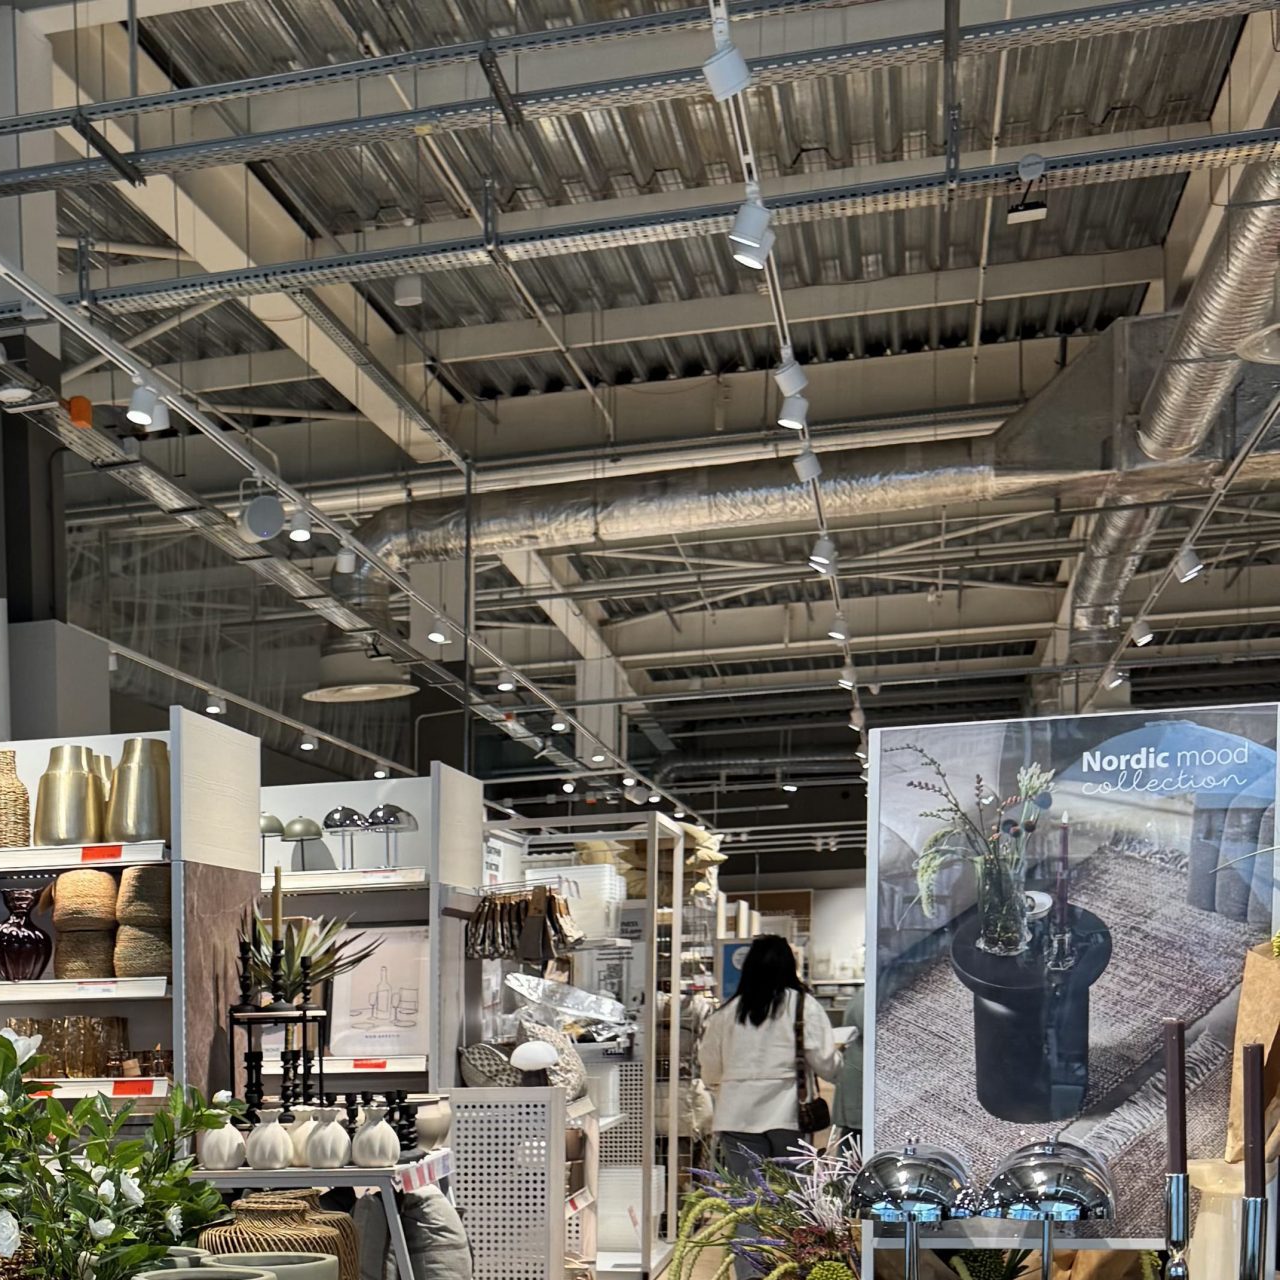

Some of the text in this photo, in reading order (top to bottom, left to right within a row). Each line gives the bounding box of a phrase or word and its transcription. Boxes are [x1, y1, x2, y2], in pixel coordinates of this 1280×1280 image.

[1082, 741, 1249, 773] Nordic mood
[1081, 769, 1248, 795] collection
